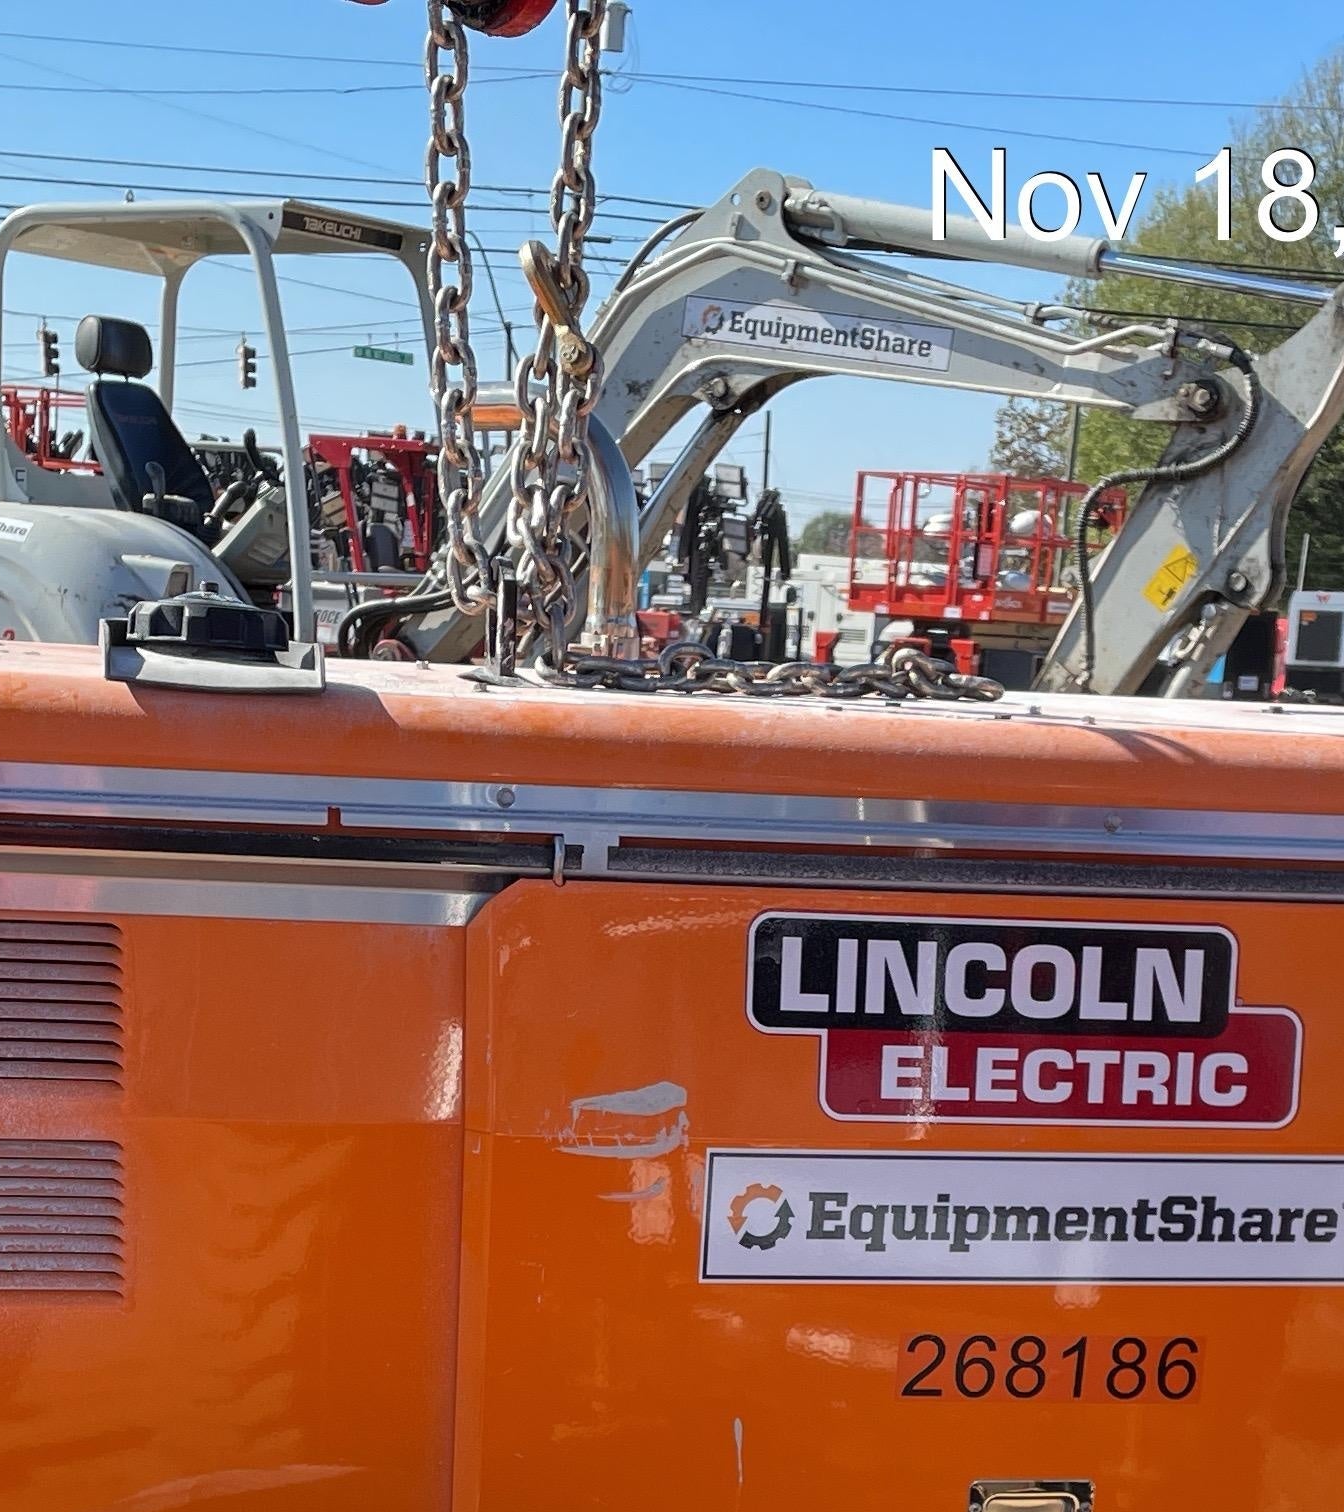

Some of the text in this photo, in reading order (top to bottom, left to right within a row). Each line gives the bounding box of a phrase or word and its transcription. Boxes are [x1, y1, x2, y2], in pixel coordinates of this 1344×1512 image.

[728, 310, 933, 358] EquipmentShare
[778, 935, 1205, 1024] LINCOLN
[880, 1043, 1250, 1108] ELECTRIC
[805, 1190, 1339, 1254] EquipmentShare
[900, 1333, 1200, 1401] 268186
